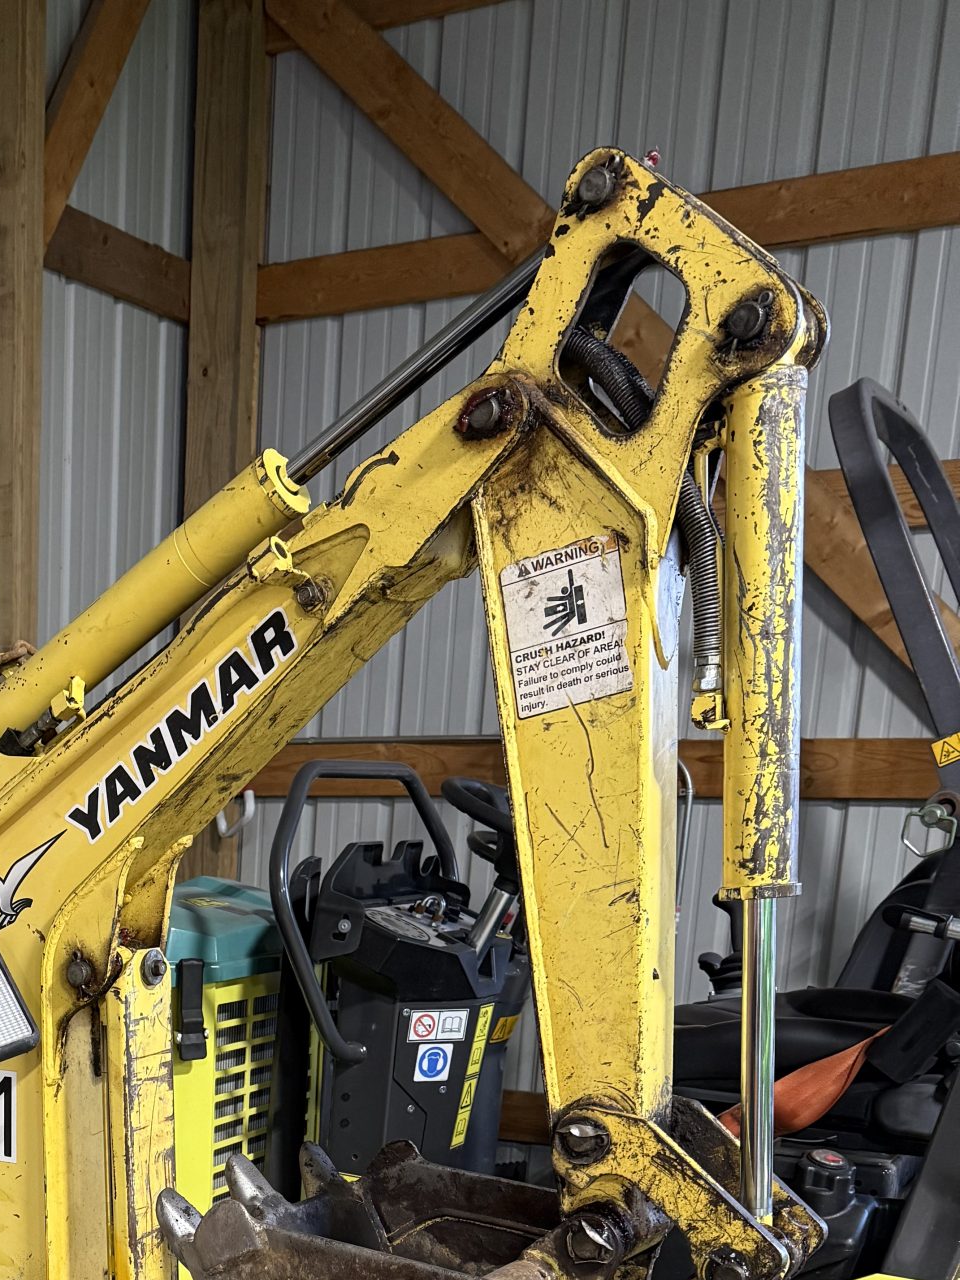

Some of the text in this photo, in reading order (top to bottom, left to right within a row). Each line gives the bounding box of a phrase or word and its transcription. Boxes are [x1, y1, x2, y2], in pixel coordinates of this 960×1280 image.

[532, 542, 598, 572] WARNING
[515, 631, 605, 663] CRUSH HAZARD!
[516, 640, 623, 676] STAY CLEAR OF AREA!
[518, 653, 621, 688] Failure to comply could
[520, 685, 544, 700] result
[546, 685, 554, 693] in
[557, 676, 581, 691] death
[596, 665, 628, 680] serious
[521, 699, 548, 712] injury.
[67, 609, 296, 841] YANMAR
